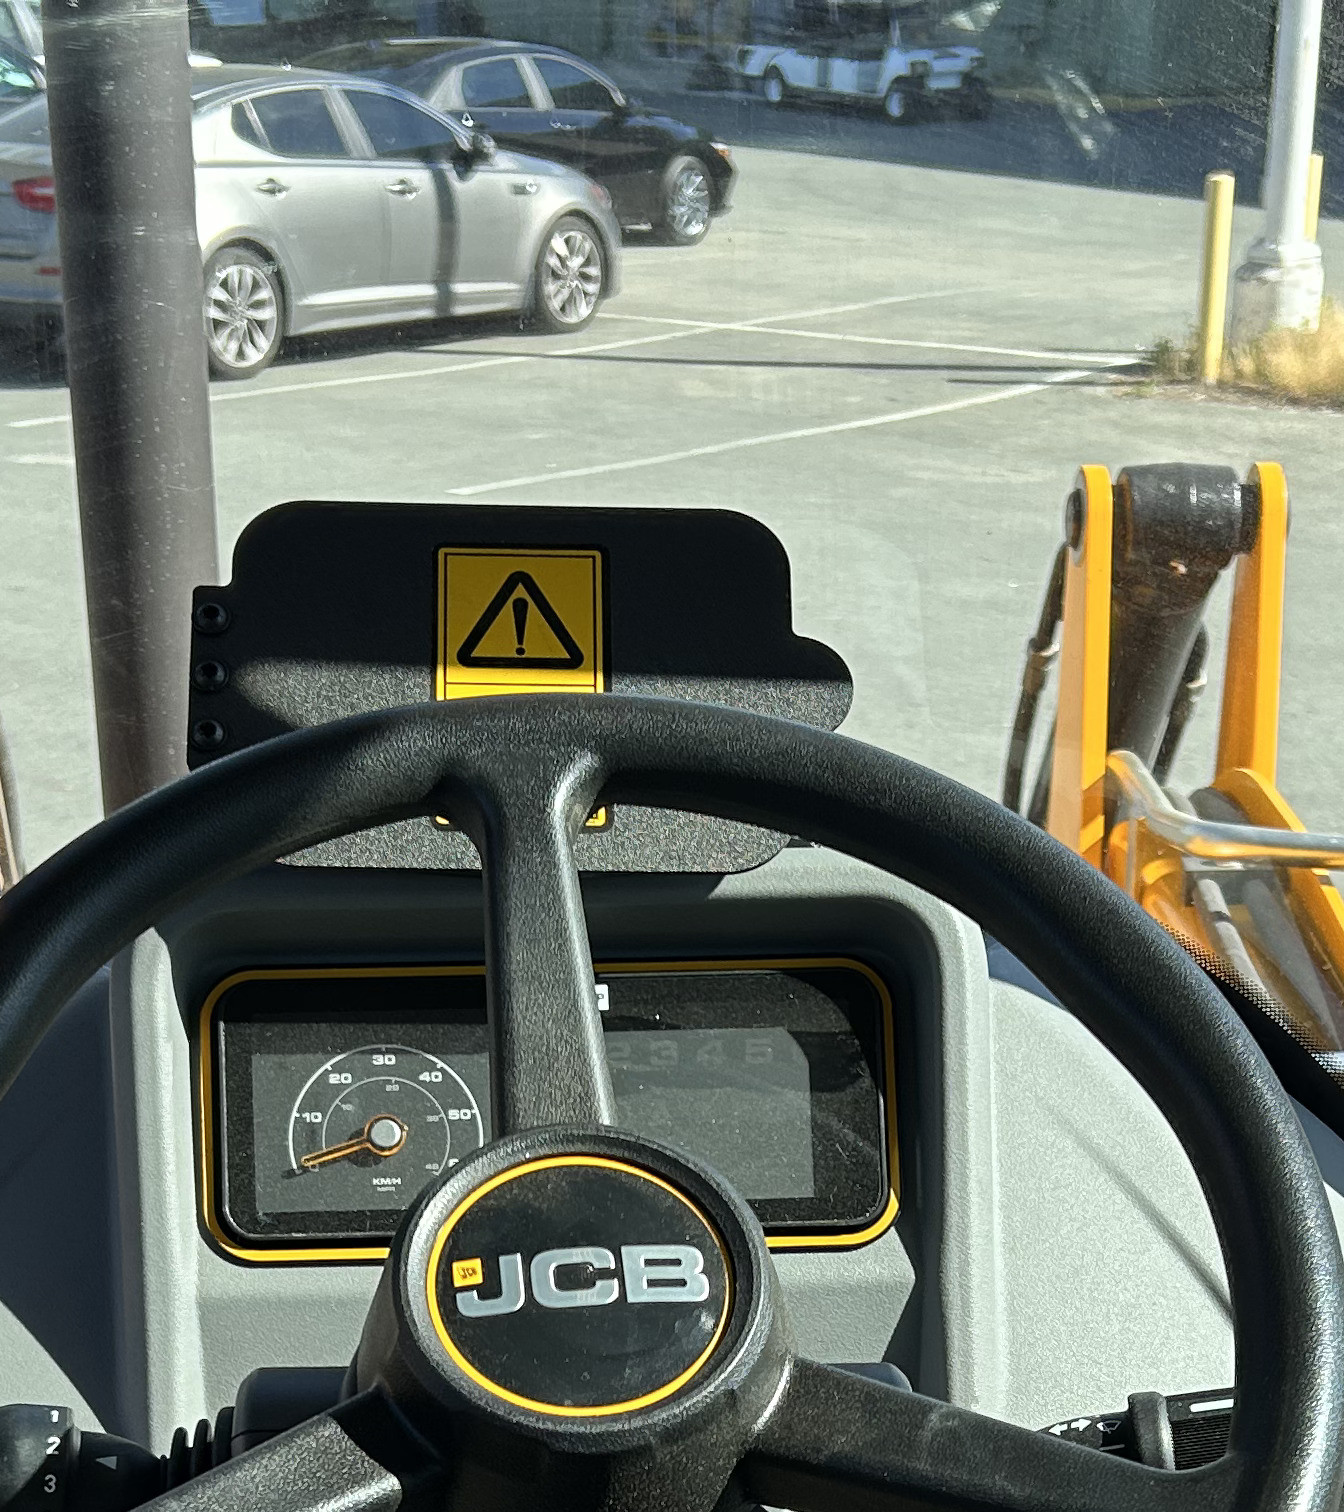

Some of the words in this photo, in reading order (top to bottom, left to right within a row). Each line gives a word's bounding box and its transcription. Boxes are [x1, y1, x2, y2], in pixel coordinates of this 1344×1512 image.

[372, 1054, 396, 1065] 30
[328, 1072, 353, 1084] 20
[418, 1071, 443, 1083] 40
[302, 1112, 323, 1123] 10
[448, 1109, 471, 1120] 50
[372, 1177, 402, 1186] KM/H
[455, 1244, 710, 1318] JCB
[50, 1410, 59, 1424] 1
[45, 1436, 60, 1456] 2
[43, 1474, 57, 1494] 3
